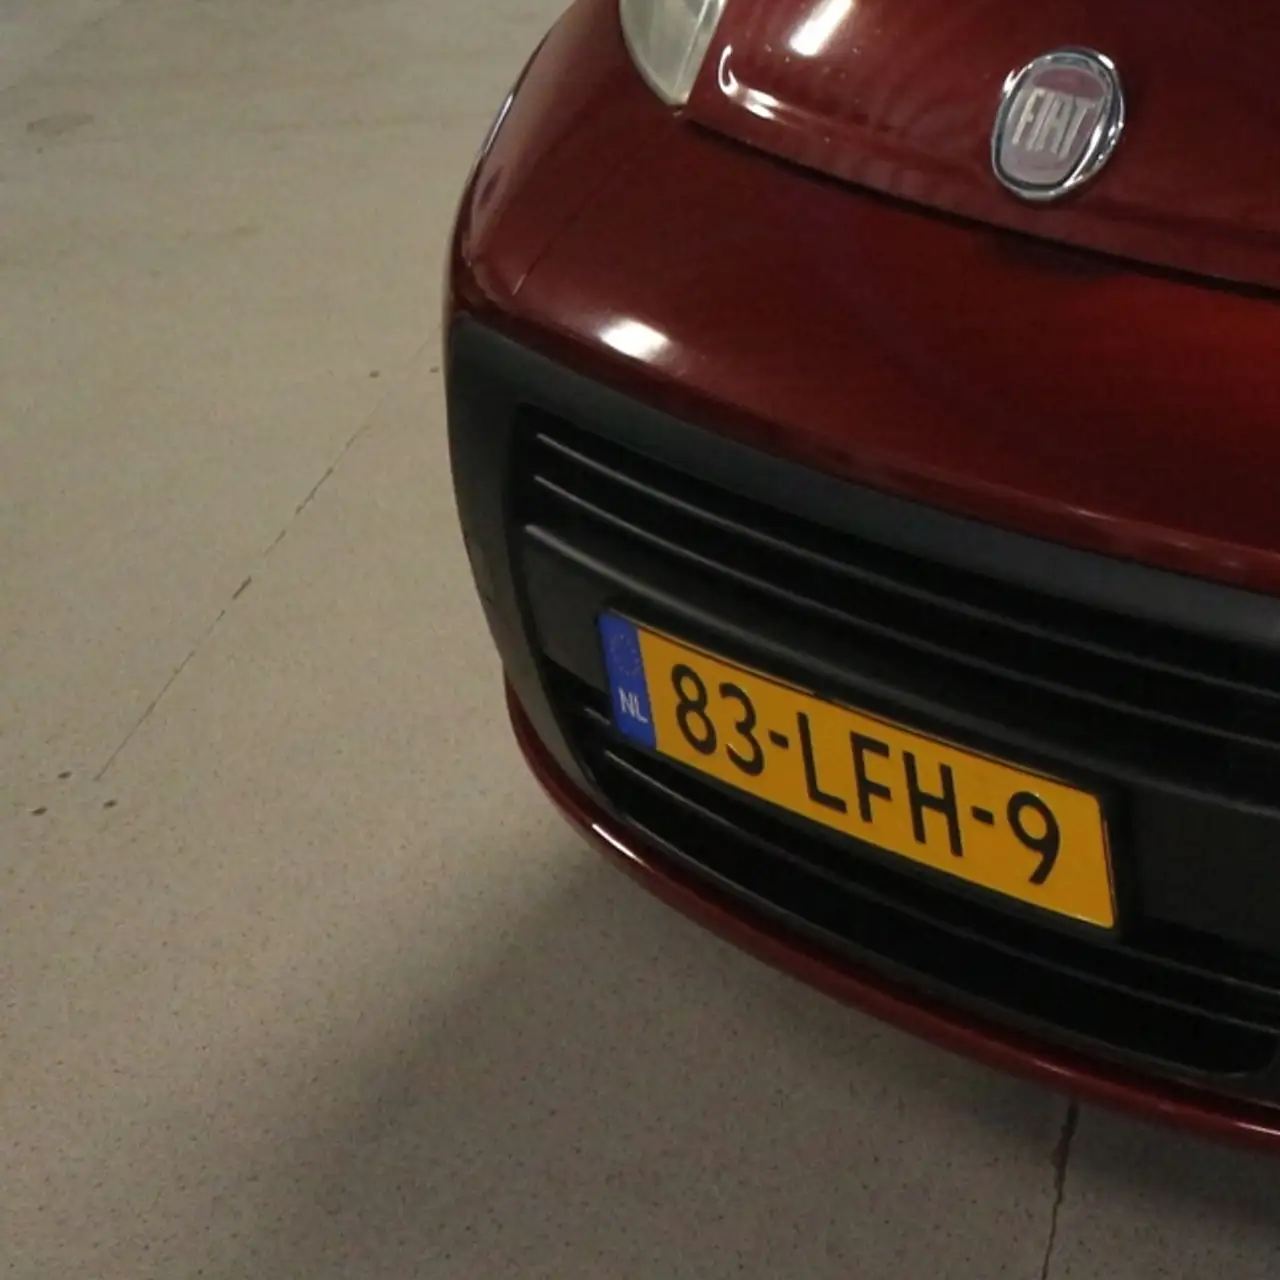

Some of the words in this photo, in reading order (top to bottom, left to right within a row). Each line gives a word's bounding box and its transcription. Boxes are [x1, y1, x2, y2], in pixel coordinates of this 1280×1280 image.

[1011, 86, 1099, 161] FIAT
[618, 686, 649, 724] NL
[671, 663, 1061, 886] 83-LFH-9
